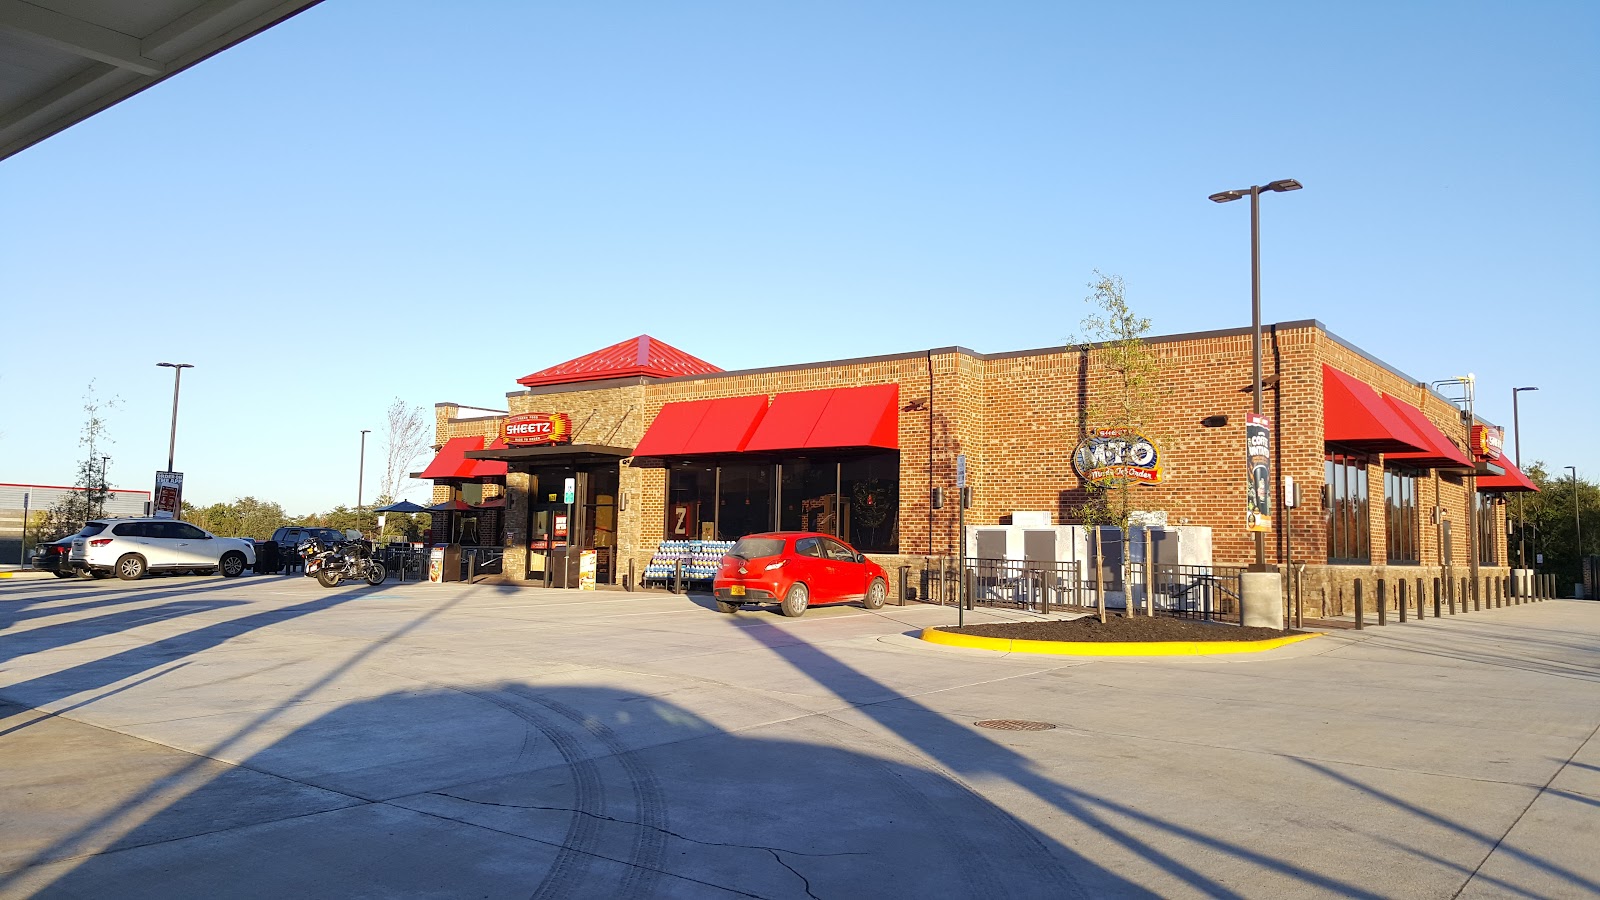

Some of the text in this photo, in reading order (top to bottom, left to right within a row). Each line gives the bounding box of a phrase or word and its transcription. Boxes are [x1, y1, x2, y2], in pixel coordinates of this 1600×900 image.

[506, 422, 551, 435] SHEETZ
[1128, 468, 1153, 480] Order
[674, 507, 687, 535] Z
